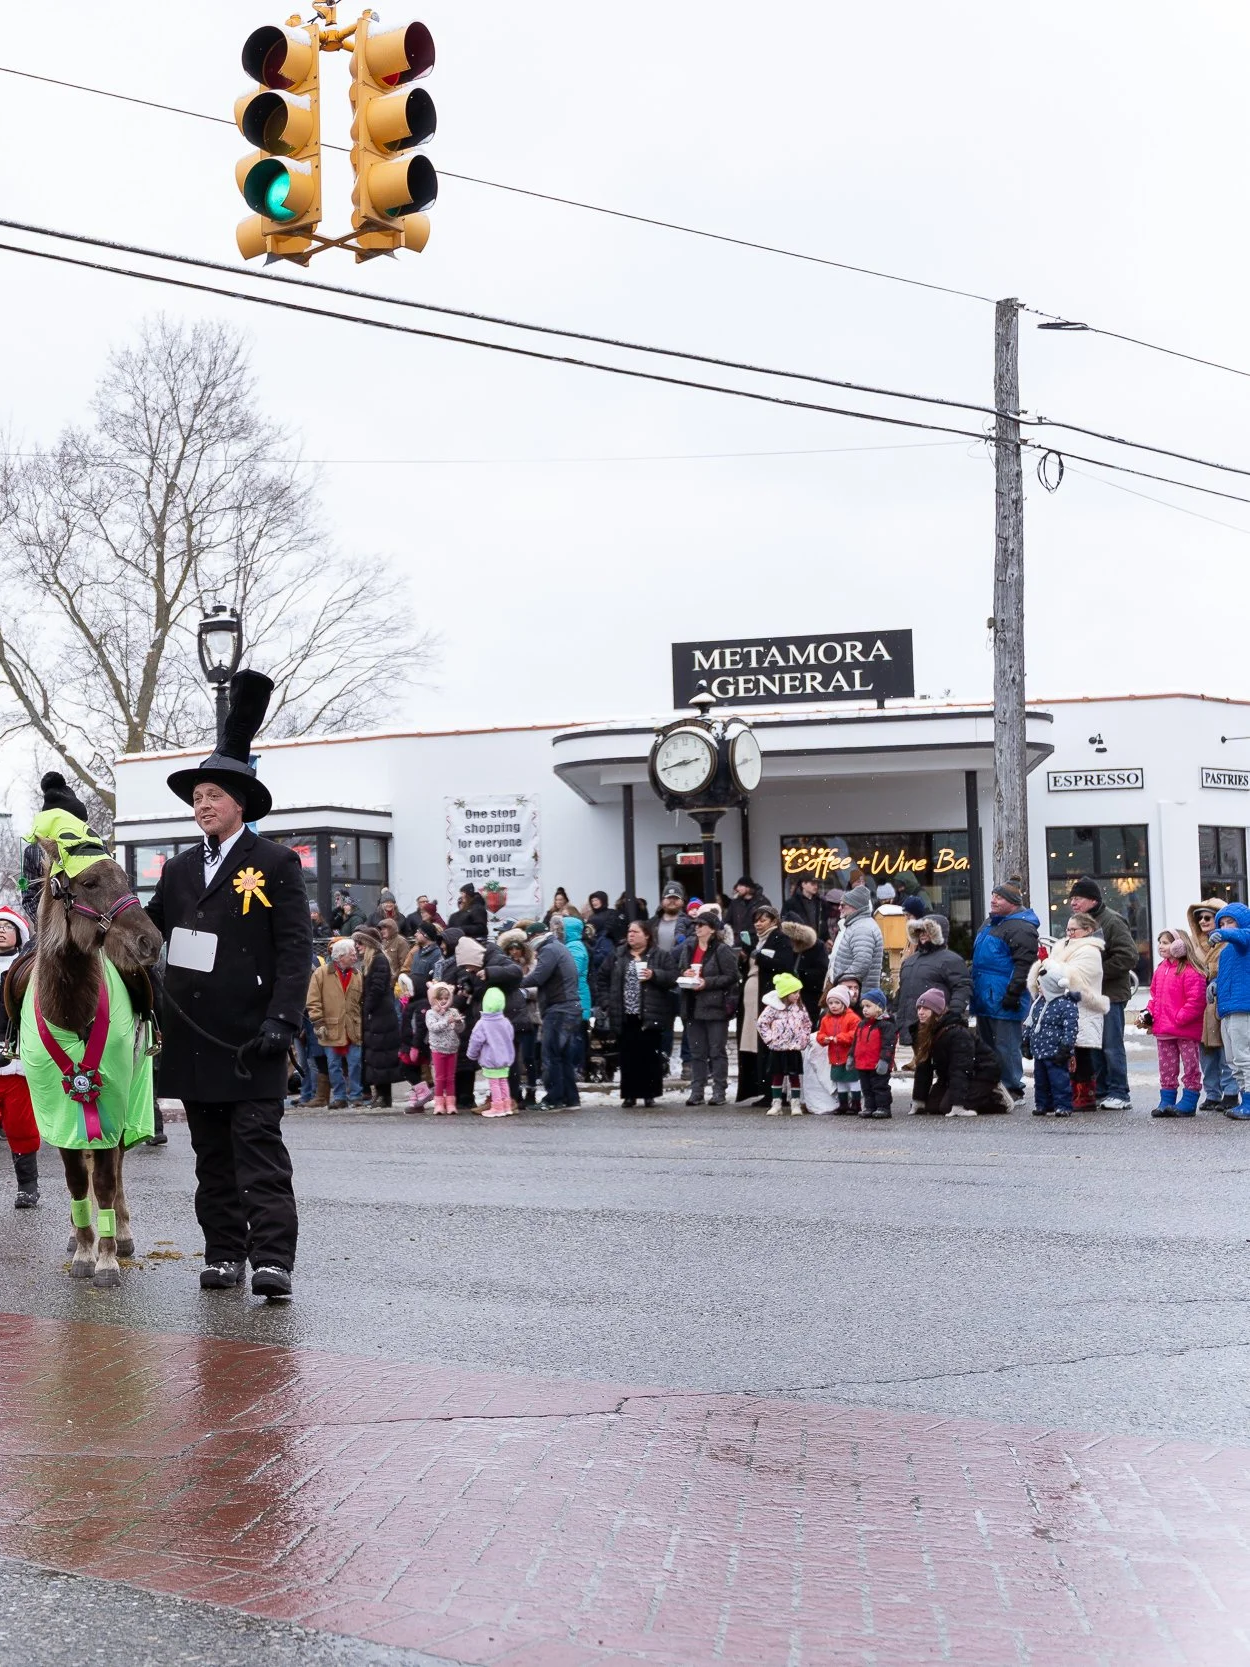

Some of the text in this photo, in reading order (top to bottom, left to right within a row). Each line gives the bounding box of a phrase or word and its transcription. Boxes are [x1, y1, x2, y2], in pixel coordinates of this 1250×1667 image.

[692, 639, 892, 672] METAMORA
[711, 669, 874, 698] GENERAL
[1053, 772, 1139, 788] ESPRESSO
[1205, 772, 1250, 787] PASTRIES
[465, 809, 517, 819] One stop
[464, 823, 521, 834] shopping
[458, 838, 522, 848] for everyone
[470, 853, 512, 863] on your
[784, 848, 852, 879] Coffee
[871, 849, 928, 875] Wine
[933, 848, 970, 873] Ba
